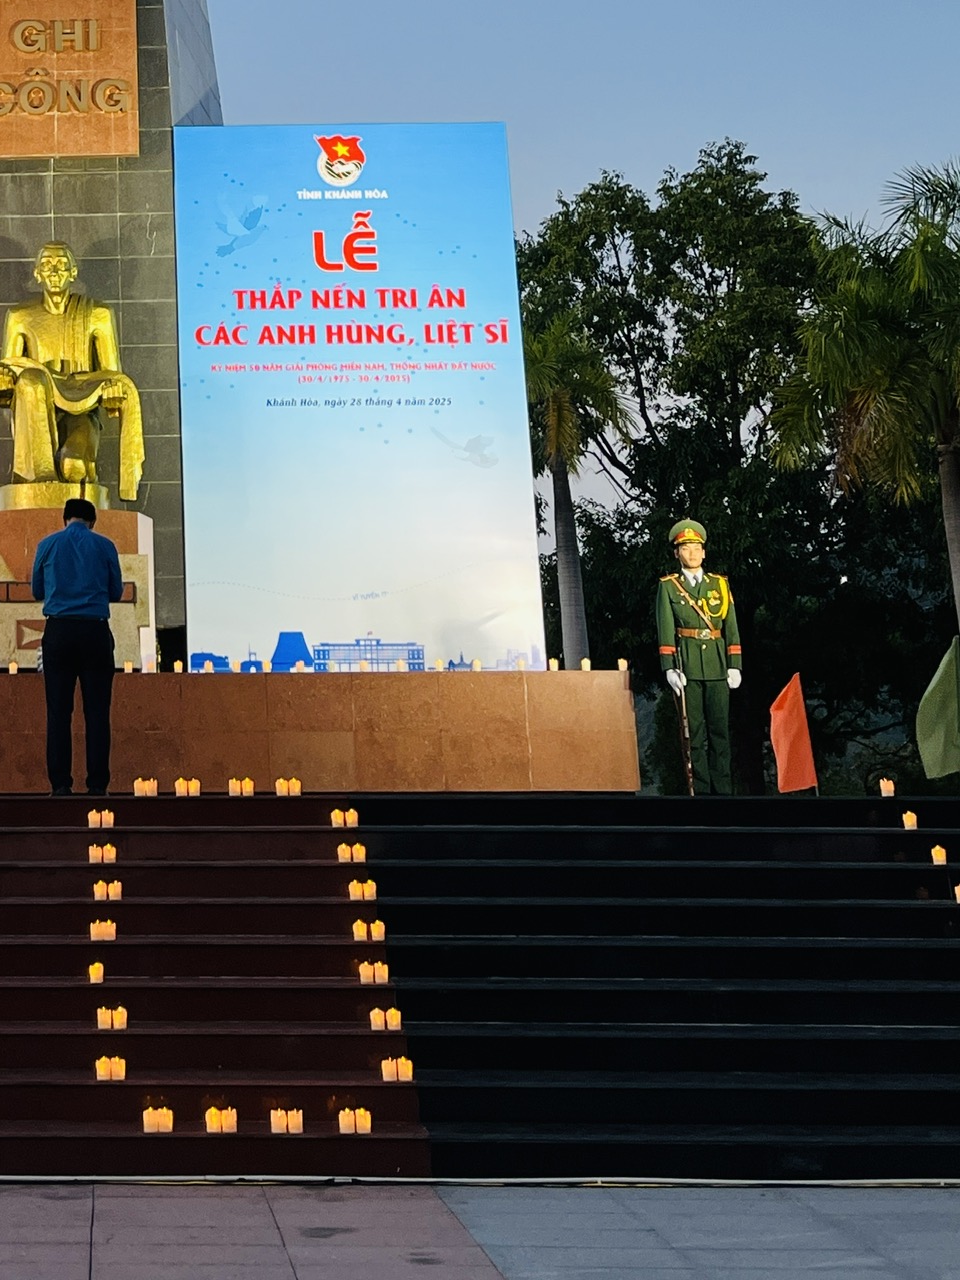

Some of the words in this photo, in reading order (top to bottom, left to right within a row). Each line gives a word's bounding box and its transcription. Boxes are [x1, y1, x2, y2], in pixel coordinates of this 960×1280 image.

[12, 19, 98, 53] GHI
[296, 188, 322, 200] TỈNH
[324, 188, 362, 200] KHÁNH
[364, 188, 388, 199] HÒA
[312, 210, 379, 273] LỄ
[232, 281, 302, 310] THẮP
[311, 282, 366, 310] NẾN
[374, 288, 417, 309] TRI
[427, 283, 466, 309] ÂN
[194, 321, 249, 346] CÁC
[257, 324, 317, 346] ANH
[325, 319, 415, 346] HÙNG,
[423, 319, 475, 349] LIỆT
[483, 318, 509, 344] SĨ
[266, 397, 297, 407] Khánh
[324, 398, 347, 409] ngày
[365, 396, 393, 408] tháng
[396, 398, 402, 406] 4
[404, 397, 426, 407] năm
[428, 397, 452, 406] 2025
